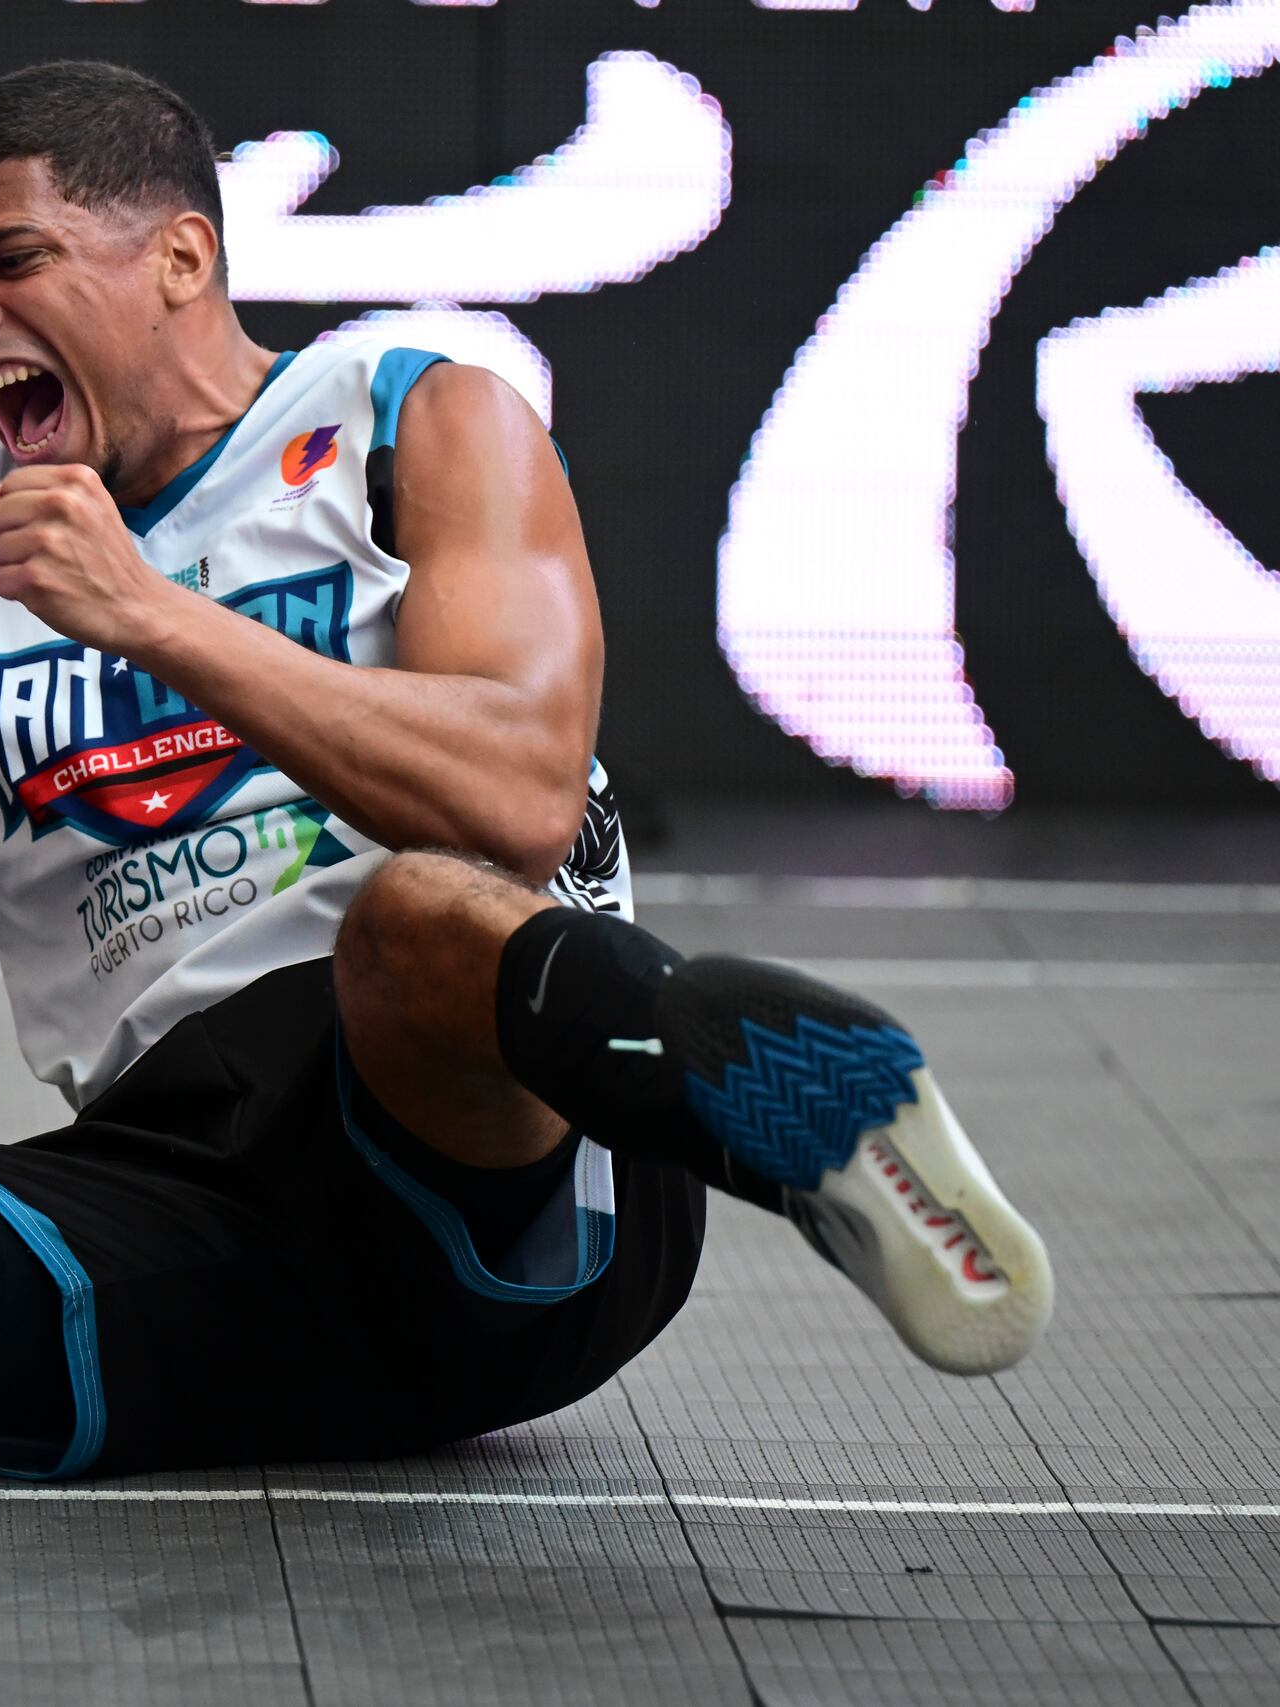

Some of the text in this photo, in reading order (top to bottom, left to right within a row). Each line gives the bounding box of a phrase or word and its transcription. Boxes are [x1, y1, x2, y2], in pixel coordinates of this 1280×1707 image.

[52, 726, 242, 791] CHALLENGE
[76, 825, 247, 953] TURISMO
[90, 878, 257, 983] PUERTO RICO
